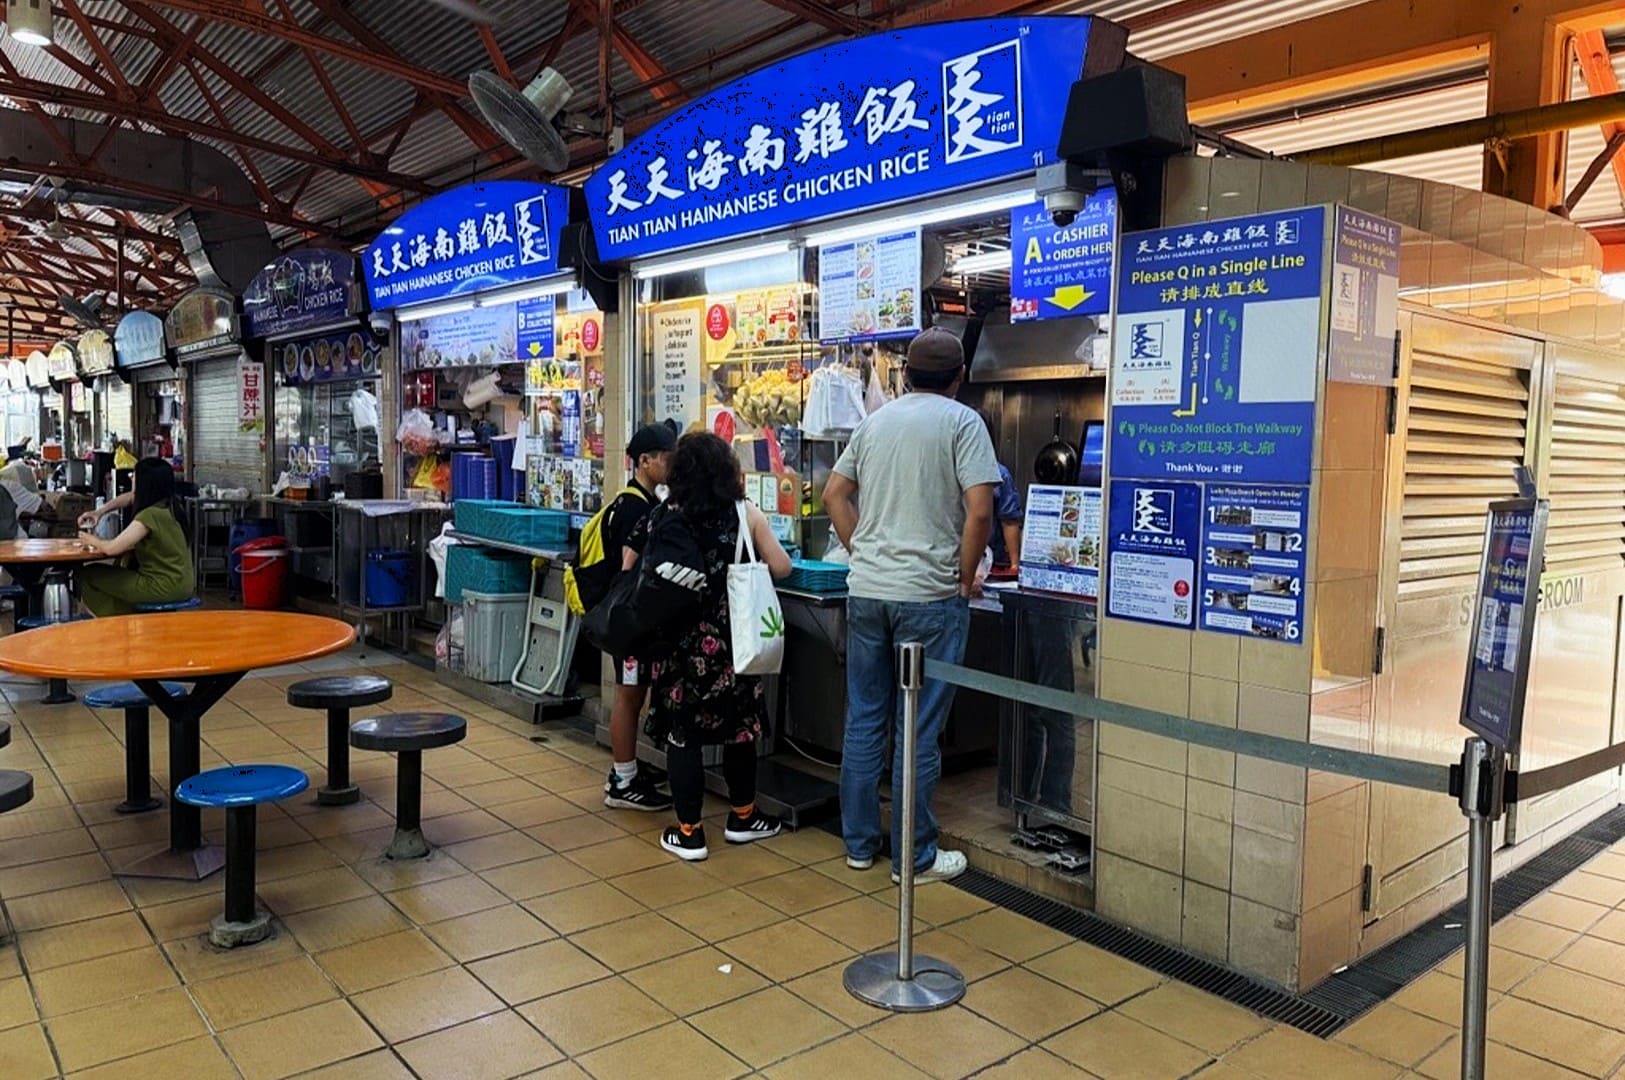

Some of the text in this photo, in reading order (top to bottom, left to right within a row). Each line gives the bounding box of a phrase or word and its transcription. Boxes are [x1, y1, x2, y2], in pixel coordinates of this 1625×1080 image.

[986, 110, 1011, 124] tian
[991, 121, 1015, 135] tian
[1032, 150, 1044, 166] 11
[608, 148, 930, 245] TIAN TIAN HAINANESE CHICKEN RICE
[1053, 222, 1109, 245] CASHIER
[1024, 237, 1044, 266] A
[1053, 241, 1113, 262] ORDER HER
[1215, 242, 1250, 254] CHICKEN
[1251, 240, 1269, 250] RICE
[374, 254, 516, 299] TIAN TIAN HAINANESE CHICKEN RICE
[1131, 253, 1305, 285] Please Q in a Single Line
[1159, 277, 1270, 304] 请排成直线
[518, 311, 526, 330] B
[1138, 421, 1303, 437] Please Do Not Block The Walkway
[1165, 462, 1213, 473] Thank You
[1208, 506, 1215, 524] 1
[1291, 532, 1302, 552] 2
[1206, 546, 1215, 564] 3
[1289, 577, 1301, 596] 4
[1543, 576, 1584, 610] ROOM
[1203, 588, 1214, 606] 5
[1287, 620, 1299, 639] 6
